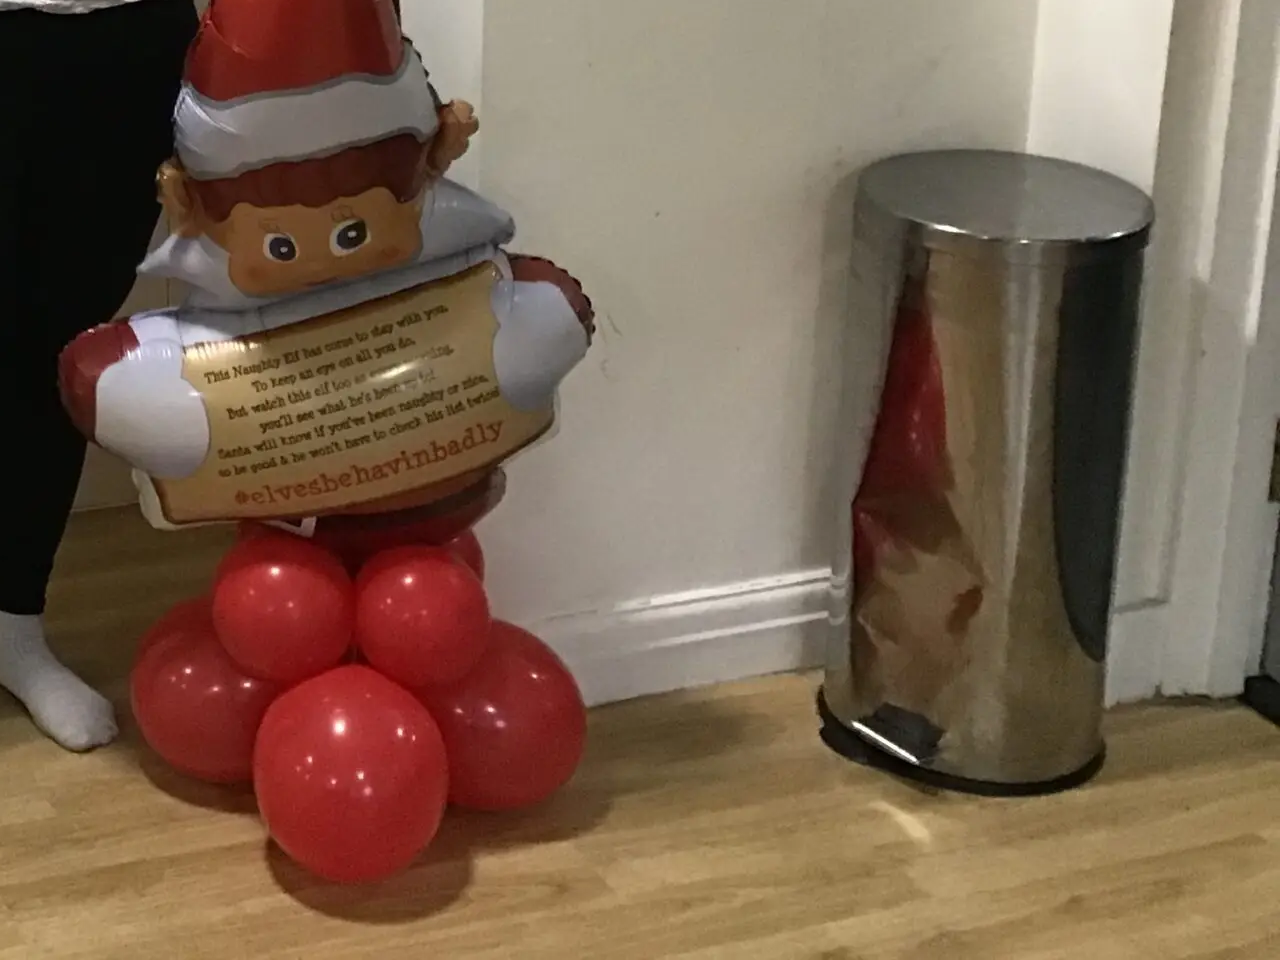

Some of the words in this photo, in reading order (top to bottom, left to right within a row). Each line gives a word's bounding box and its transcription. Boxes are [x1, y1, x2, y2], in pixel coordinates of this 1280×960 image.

[204, 371, 230, 385] This
[232, 357, 280, 379] Naughty
[283, 349, 301, 365] Elf
[303, 344, 322, 360] has
[324, 337, 354, 353] come
[355, 330, 369, 343] to
[370, 324, 394, 338] stay
[396, 312, 421, 327] with
[251, 380, 268, 393] To
[271, 373, 296, 389] keep
[299, 368, 314, 380] an
[316, 363, 336, 378] eye
[338, 357, 355, 369] on
[356, 348, 372, 363] all
[374, 343, 396, 360] you
[217, 446, 252, 460] Santa
[254, 438, 278, 451] will
[279, 430, 313, 446] know
[313, 424, 325, 437] if
[327, 416, 366, 435] you've
[367, 406, 396, 423] been
[398, 390, 445, 412] naughty
[446, 384, 459, 395] or
[226, 405, 248, 420] But
[251, 396, 286, 414] watch
[287, 390, 310, 404] this
[314, 382, 330, 397] elf
[331, 379, 352, 392] too
[259, 414, 293, 434] you'll
[296, 410, 314, 423] see
[317, 400, 347, 419] what
[348, 392, 371, 407] he's
[234, 464, 247, 474] be
[250, 457, 278, 473] good
[291, 451, 307, 463] he
[308, 441, 343, 458] won't
[344, 434, 371, 450] have
[373, 429, 387, 441] to
[389, 416, 422, 436] check
[424, 408, 445, 424] his
[445, 399, 466, 416] list
[235, 420, 504, 505] #elvesbehavinbadly
